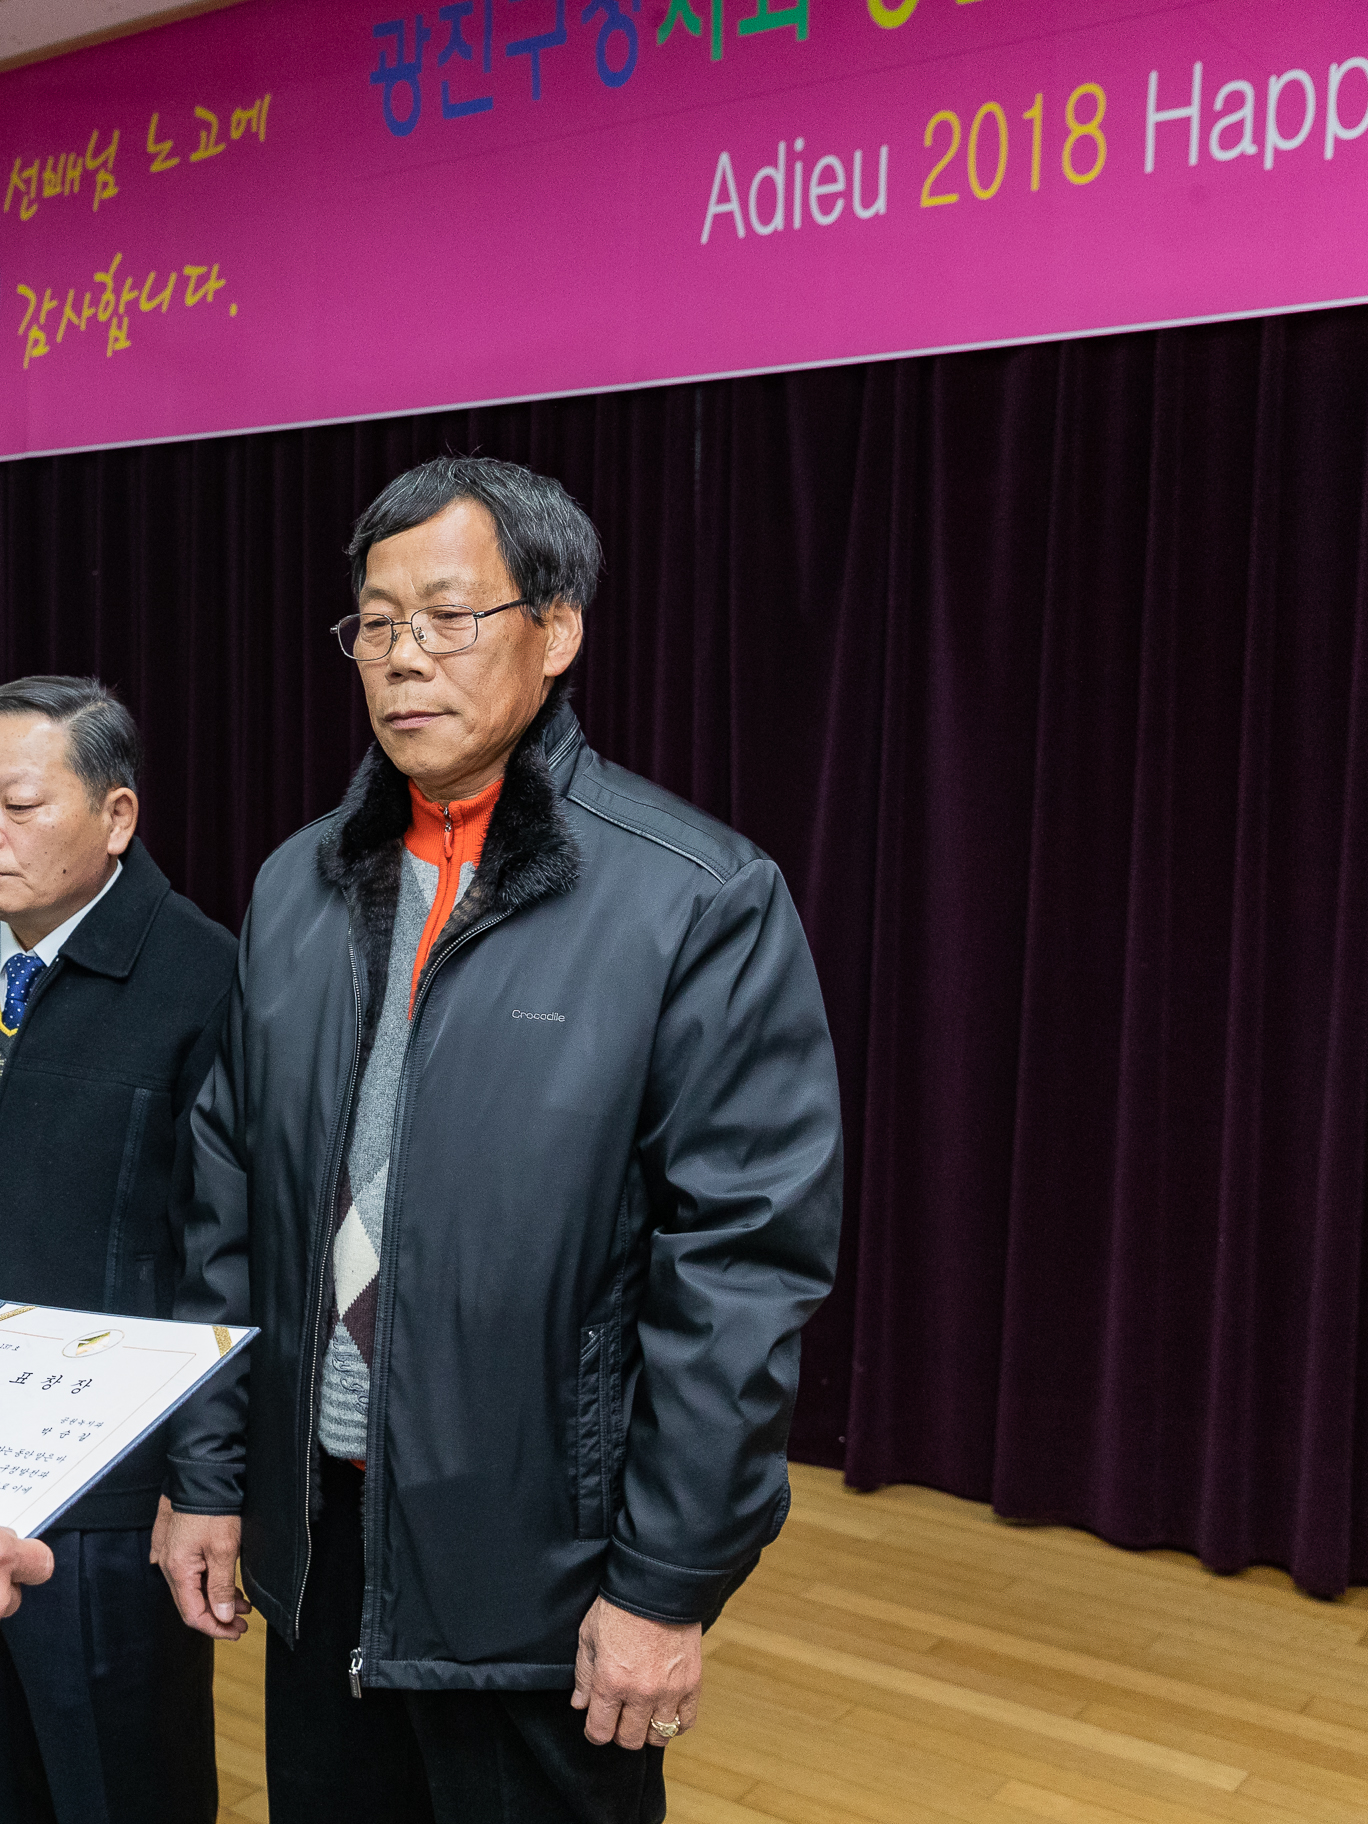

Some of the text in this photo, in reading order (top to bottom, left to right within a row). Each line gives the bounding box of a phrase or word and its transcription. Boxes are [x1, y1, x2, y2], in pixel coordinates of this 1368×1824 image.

[3, 93, 272, 221] 선배님 노고에
[700, 138, 889, 245] Adieu
[920, 82, 1108, 208] 2018
[16, 253, 240, 369] 감사합니다.
[512, 1009, 566, 1023] Crocodile
[11, 1484, 33, 1495] 이에
